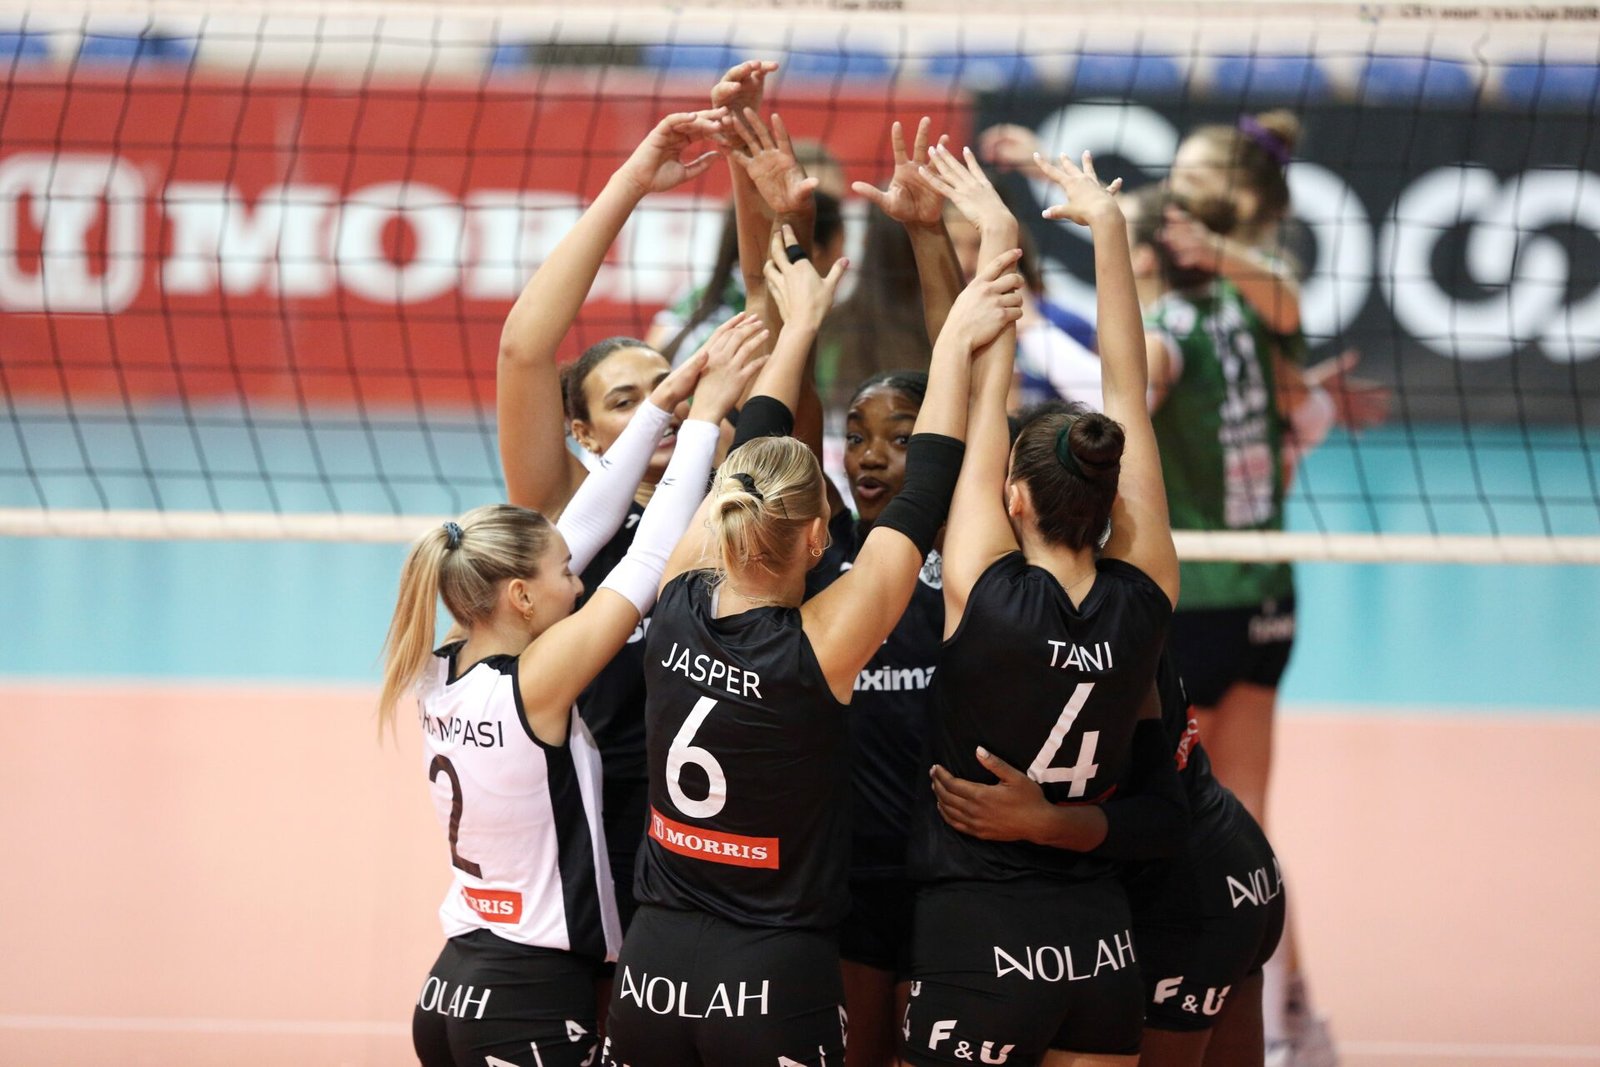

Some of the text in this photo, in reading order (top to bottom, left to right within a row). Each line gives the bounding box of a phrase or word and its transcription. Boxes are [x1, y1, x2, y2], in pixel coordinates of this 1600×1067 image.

[661, 642, 763, 699] JASPER
[1047, 639, 1113, 672] TANI
[666, 695, 727, 819] 6
[1027, 682, 1100, 798] 4
[429, 754, 483, 880] 2
[666, 827, 768, 861] MORRIS
[1226, 857, 1283, 909] NOLA
[993, 929, 1136, 982] NOLAH
[416, 976, 492, 1020] OLAH
[620, 965, 770, 1019] NOLAH
